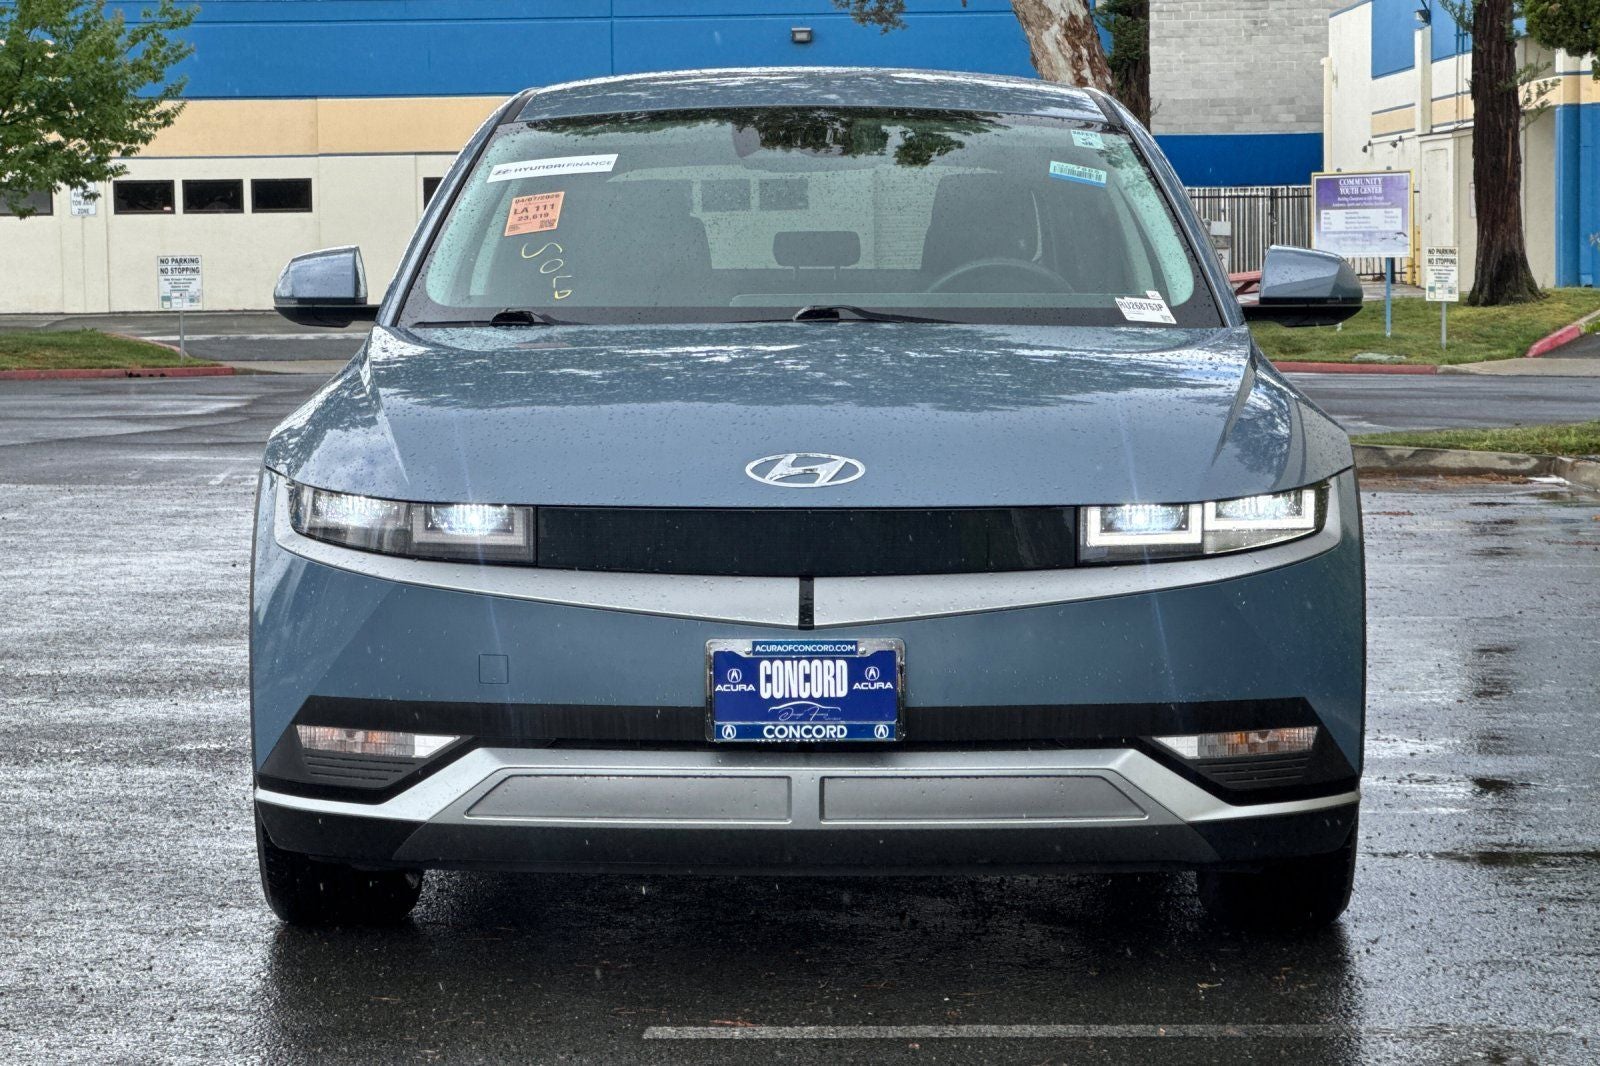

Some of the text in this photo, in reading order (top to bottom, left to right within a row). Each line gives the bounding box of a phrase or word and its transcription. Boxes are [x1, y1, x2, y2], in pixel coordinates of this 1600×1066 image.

[513, 160, 613, 172] HYUNDAI FINANCE
[1339, 177, 1383, 186] COMMUNITY
[1340, 186, 1383, 195] YOUTH CENTER
[513, 206, 529, 215] LA
[755, 644, 856, 652] ACURAOFCONCORD.COM
[759, 660, 849, 699] CONCORD
[714, 684, 756, 692] ACURA
[852, 682, 894, 690] ACURA
[763, 725, 848, 739] CONCORD
